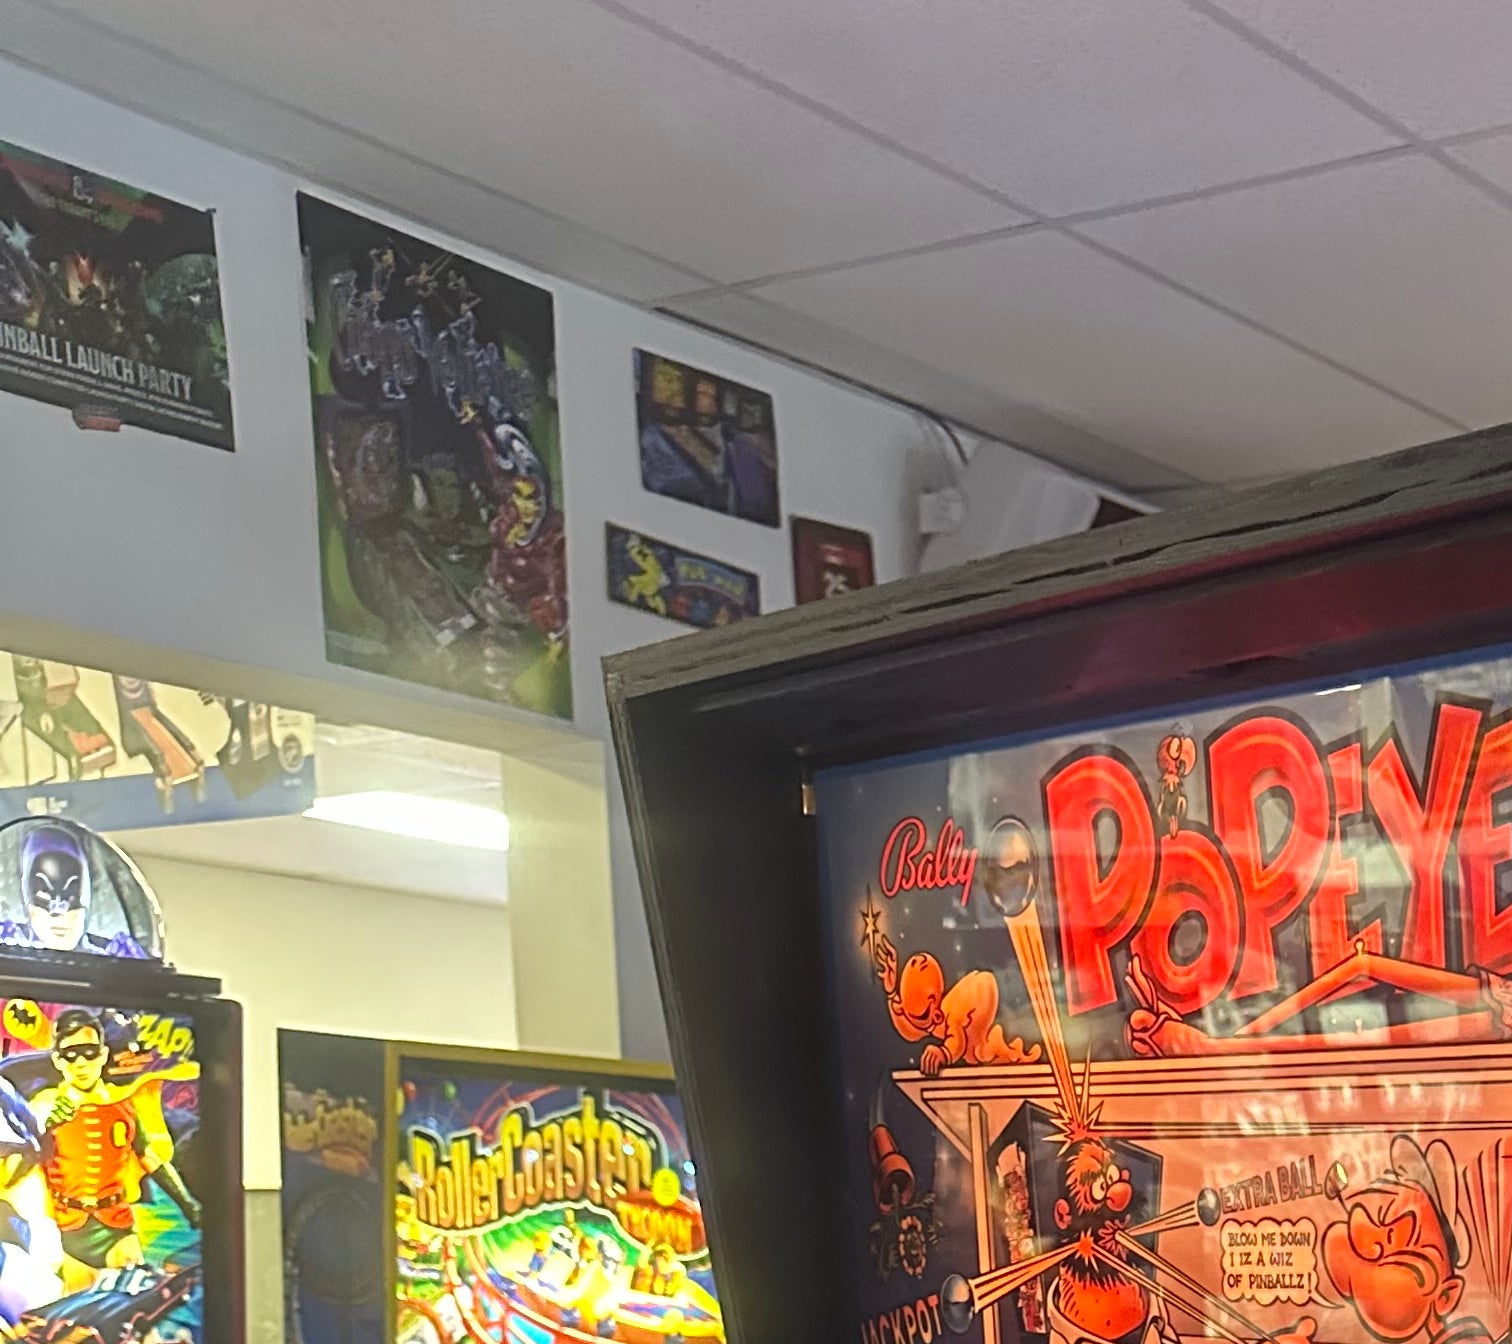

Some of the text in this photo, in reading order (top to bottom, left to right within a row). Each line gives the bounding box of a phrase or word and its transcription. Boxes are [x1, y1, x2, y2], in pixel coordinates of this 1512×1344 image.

[65, 341, 134, 384] LAUNCH
[138, 365, 192, 401] PARTY
[879, 816, 977, 906] Bally
[1221, 1154, 1323, 1215] EXTRA BALL
[1228, 1232, 1311, 1248] BLOW ME DOWN
[1230, 1252, 1293, 1266] I IZ A WIZ
[1227, 1274, 1242, 1288] OF
